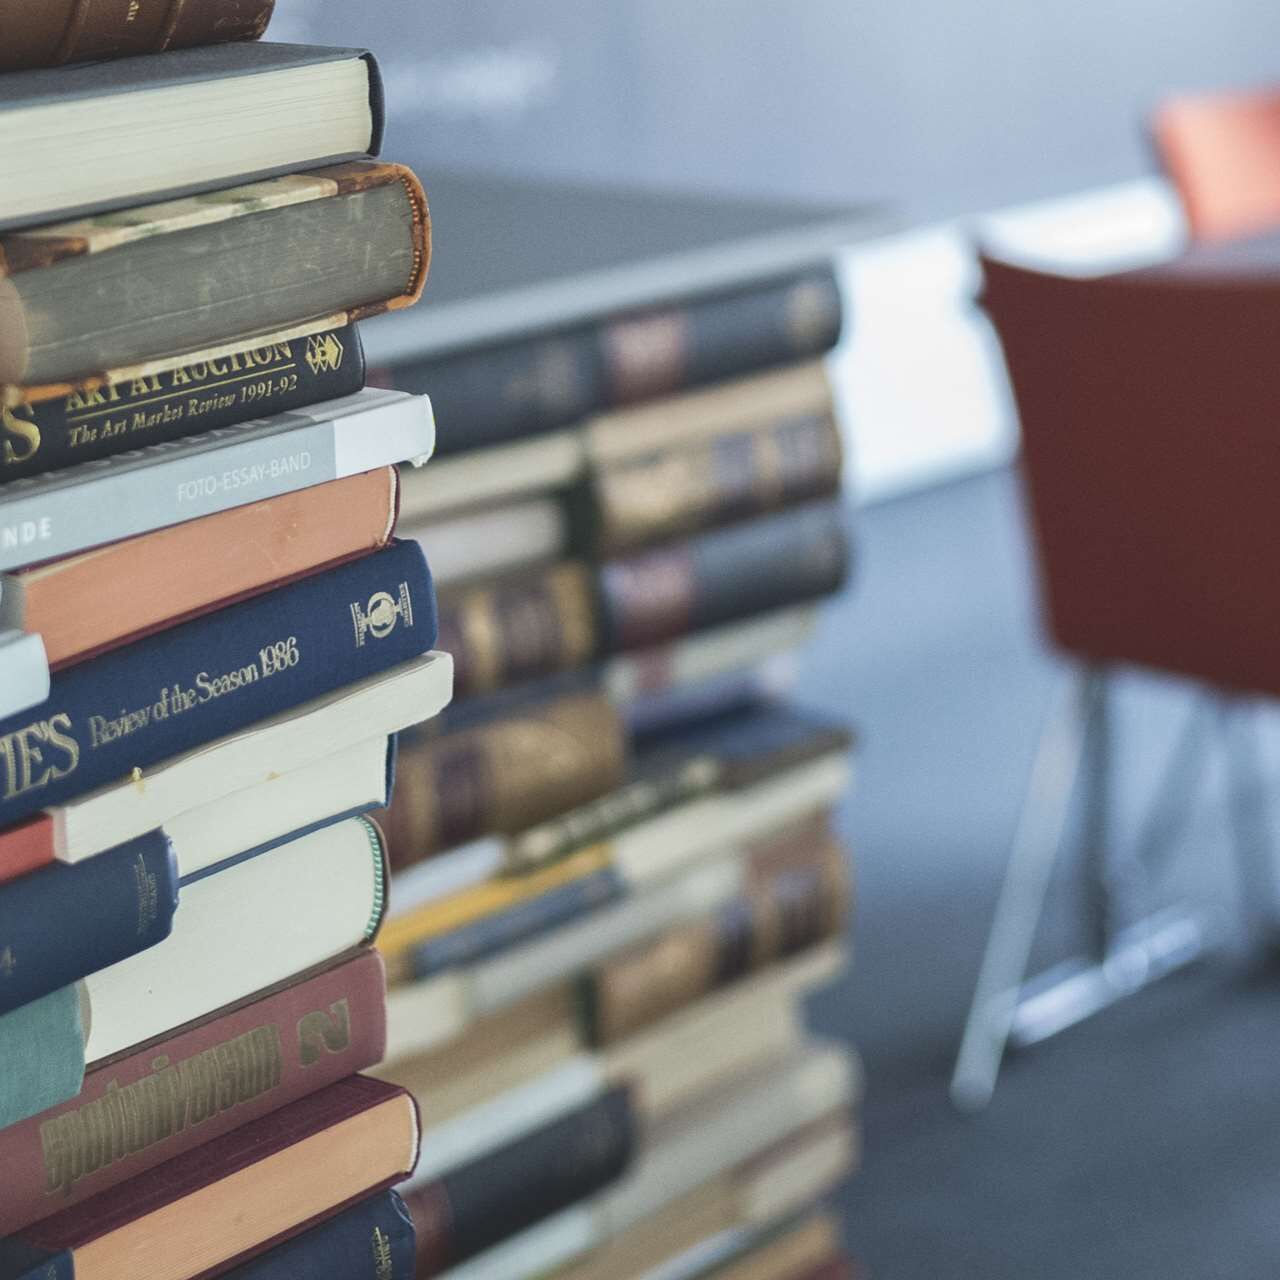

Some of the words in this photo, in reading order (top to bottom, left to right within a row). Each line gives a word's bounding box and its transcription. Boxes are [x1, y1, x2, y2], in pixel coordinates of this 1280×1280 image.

[69, 424, 98, 449] The
[100, 419, 127, 440] Art
[131, 403, 184, 432] Market
[188, 388, 237, 418] Review
[240, 373, 299, 403] 1991-92
[177, 451, 312, 504] FOTO-ESSAY-BAND
[90, 705, 149, 748] Review
[152, 688, 170, 723] of
[171, 684, 196, 716] the
[196, 662, 260, 704] Season
[259, 636, 300, 678] 1986
